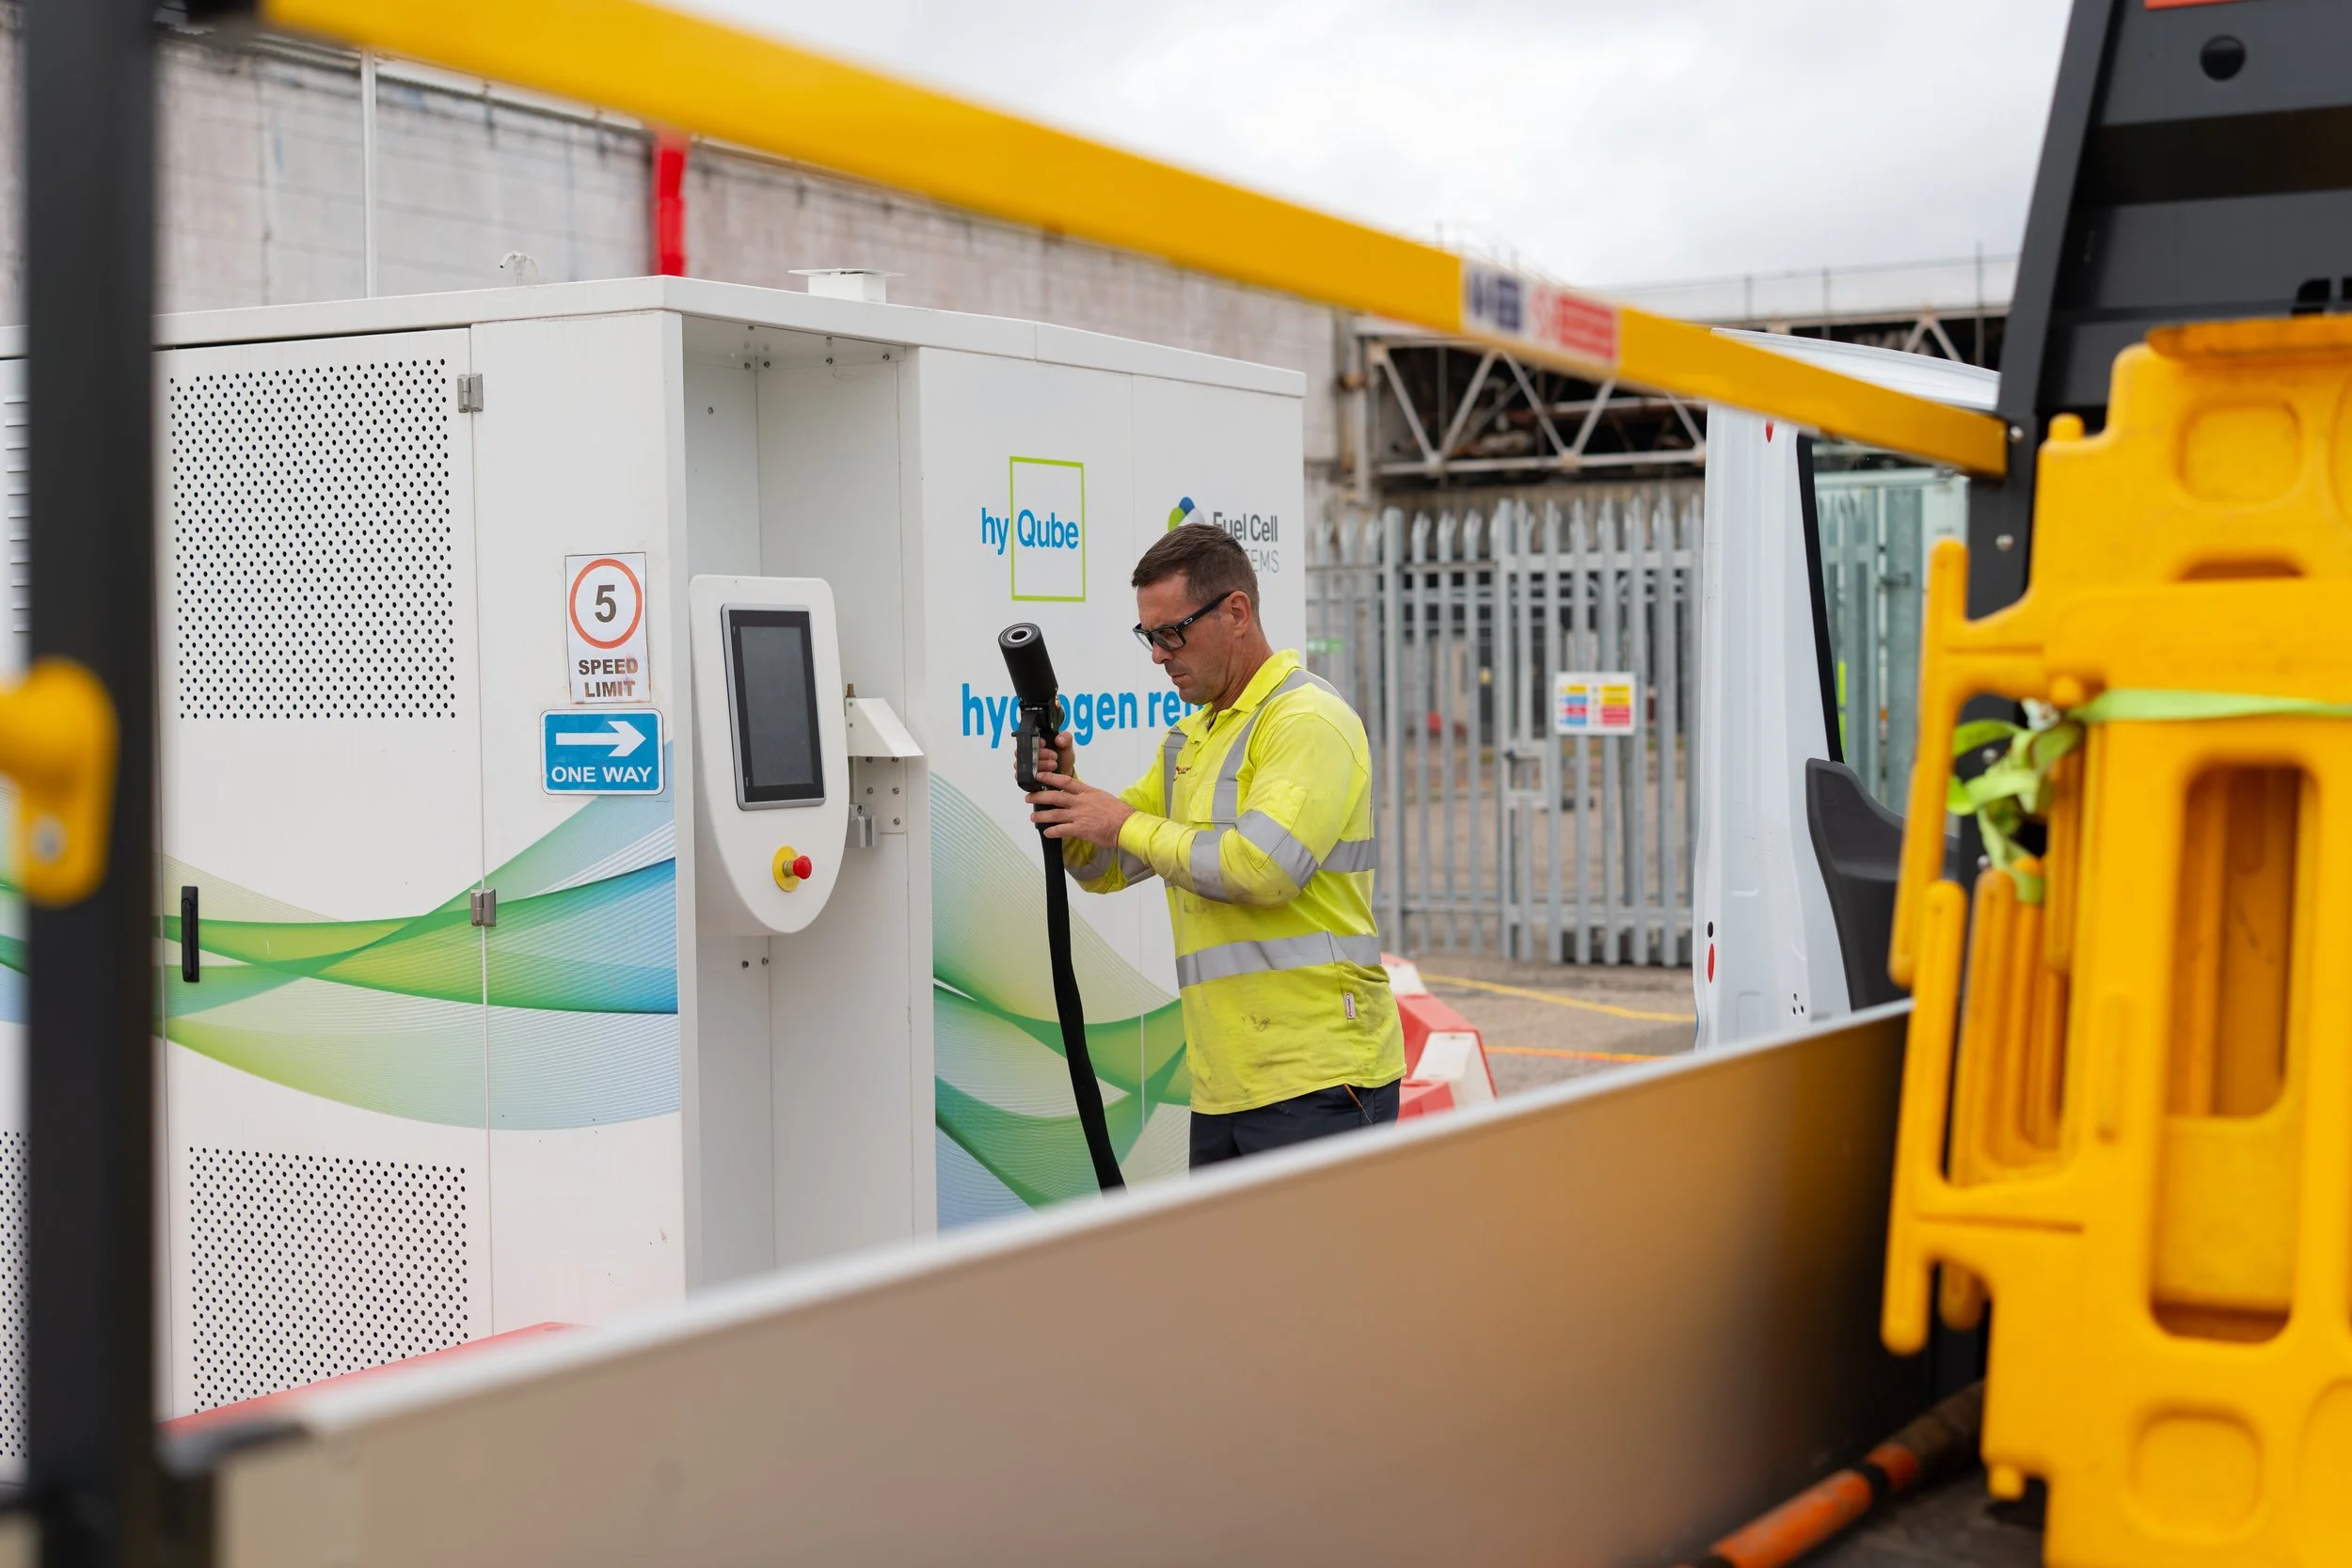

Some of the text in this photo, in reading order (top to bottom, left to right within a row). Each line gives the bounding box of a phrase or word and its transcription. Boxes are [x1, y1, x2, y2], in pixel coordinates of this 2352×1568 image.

[981, 507, 1079, 555] hy Qube
[1250, 515, 1278, 542] Cell
[1245, 549, 1279, 573] EMS
[595, 584, 617, 623] 5
[578, 658, 639, 675] SPEED
[584, 680, 636, 698] LIMIT
[551, 766, 652, 783] ONE WAY
